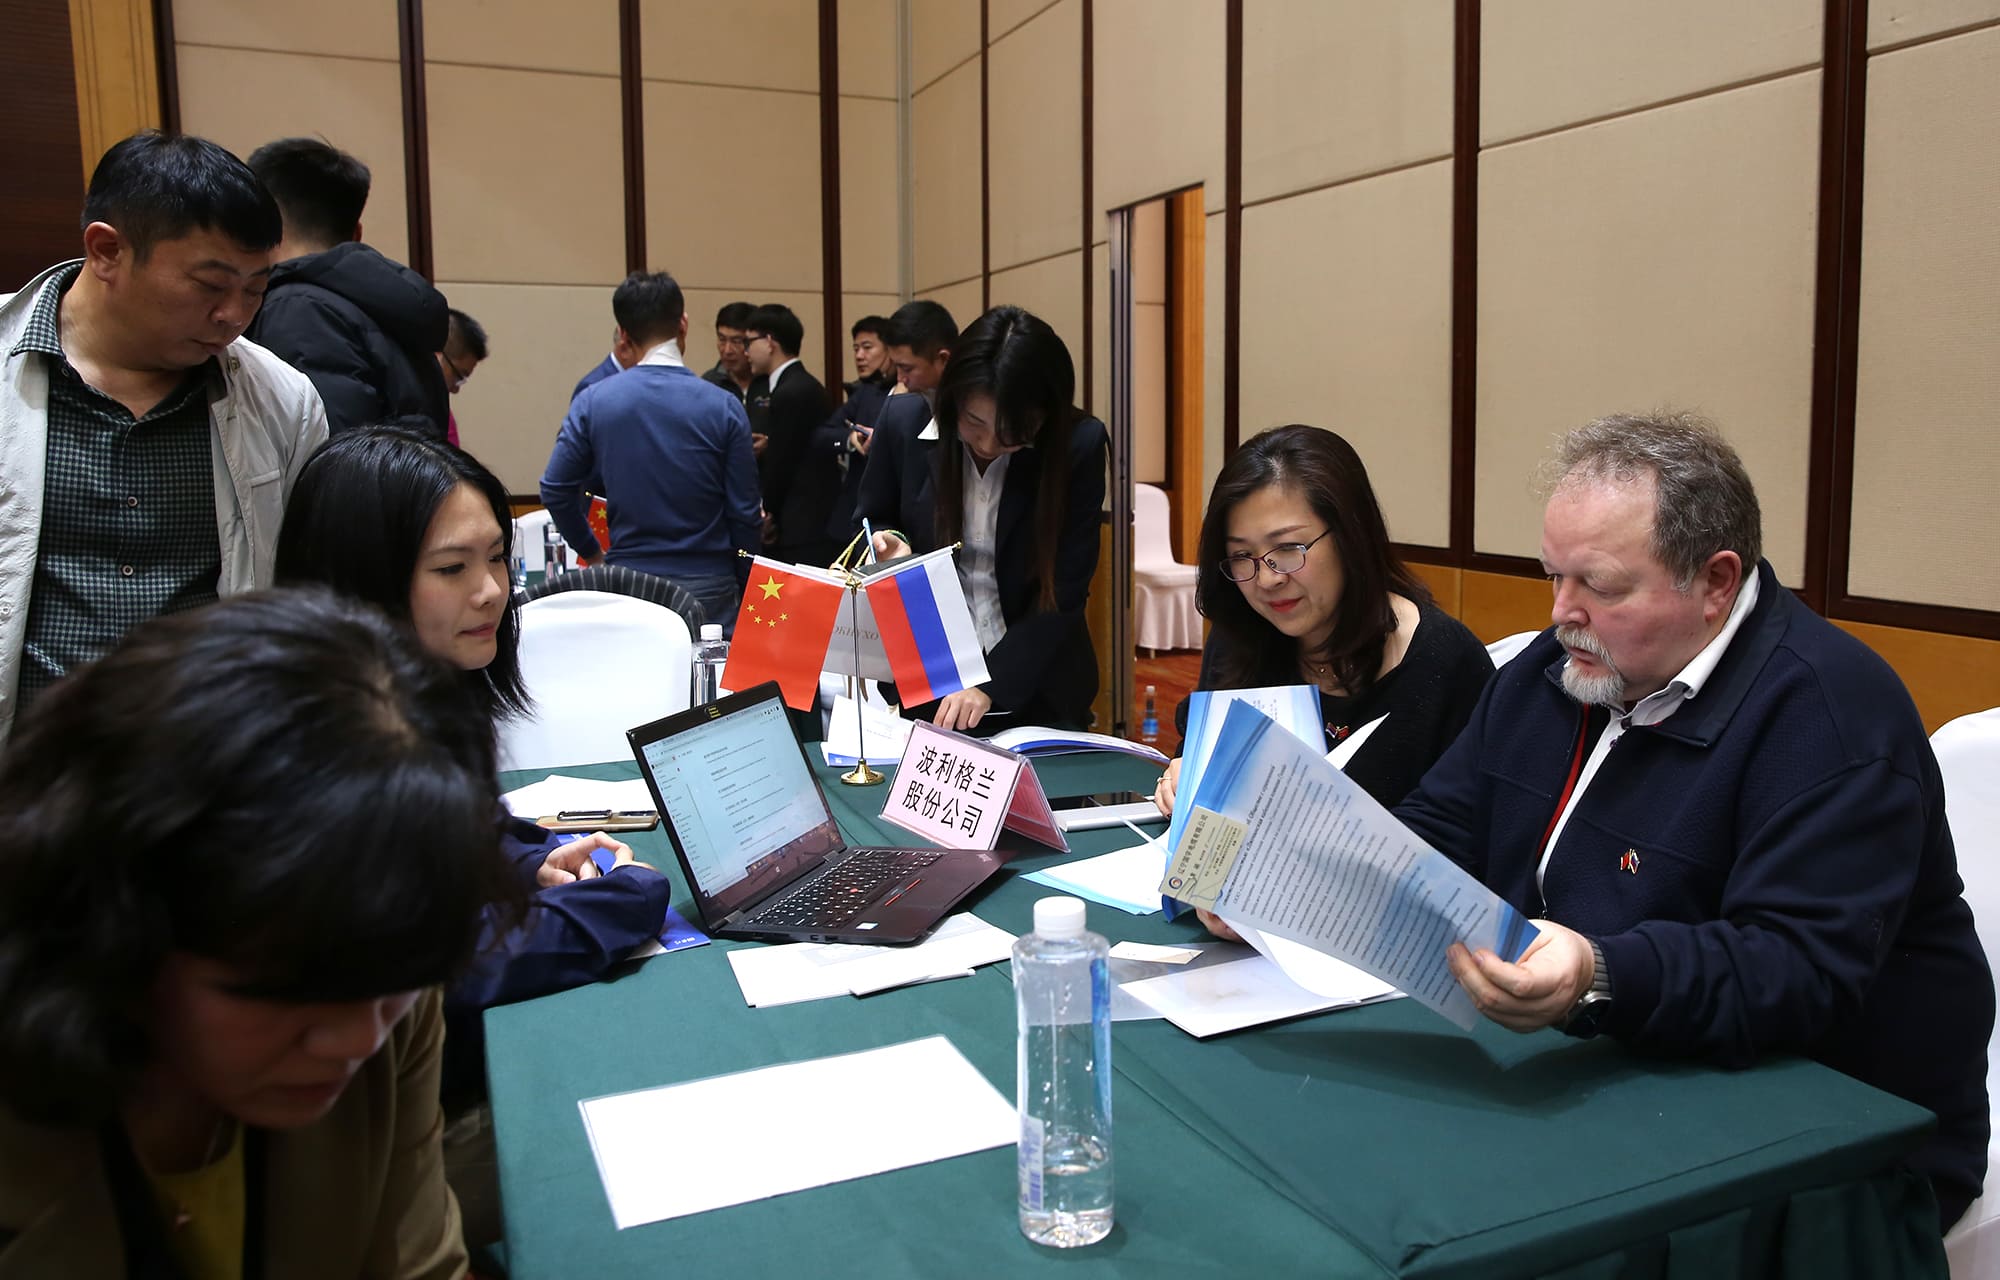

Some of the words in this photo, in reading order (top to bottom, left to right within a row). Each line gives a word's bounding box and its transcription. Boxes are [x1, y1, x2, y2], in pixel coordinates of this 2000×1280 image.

[916, 745, 995, 800] 波利格兰
[902, 780, 982, 838] 股份公司
